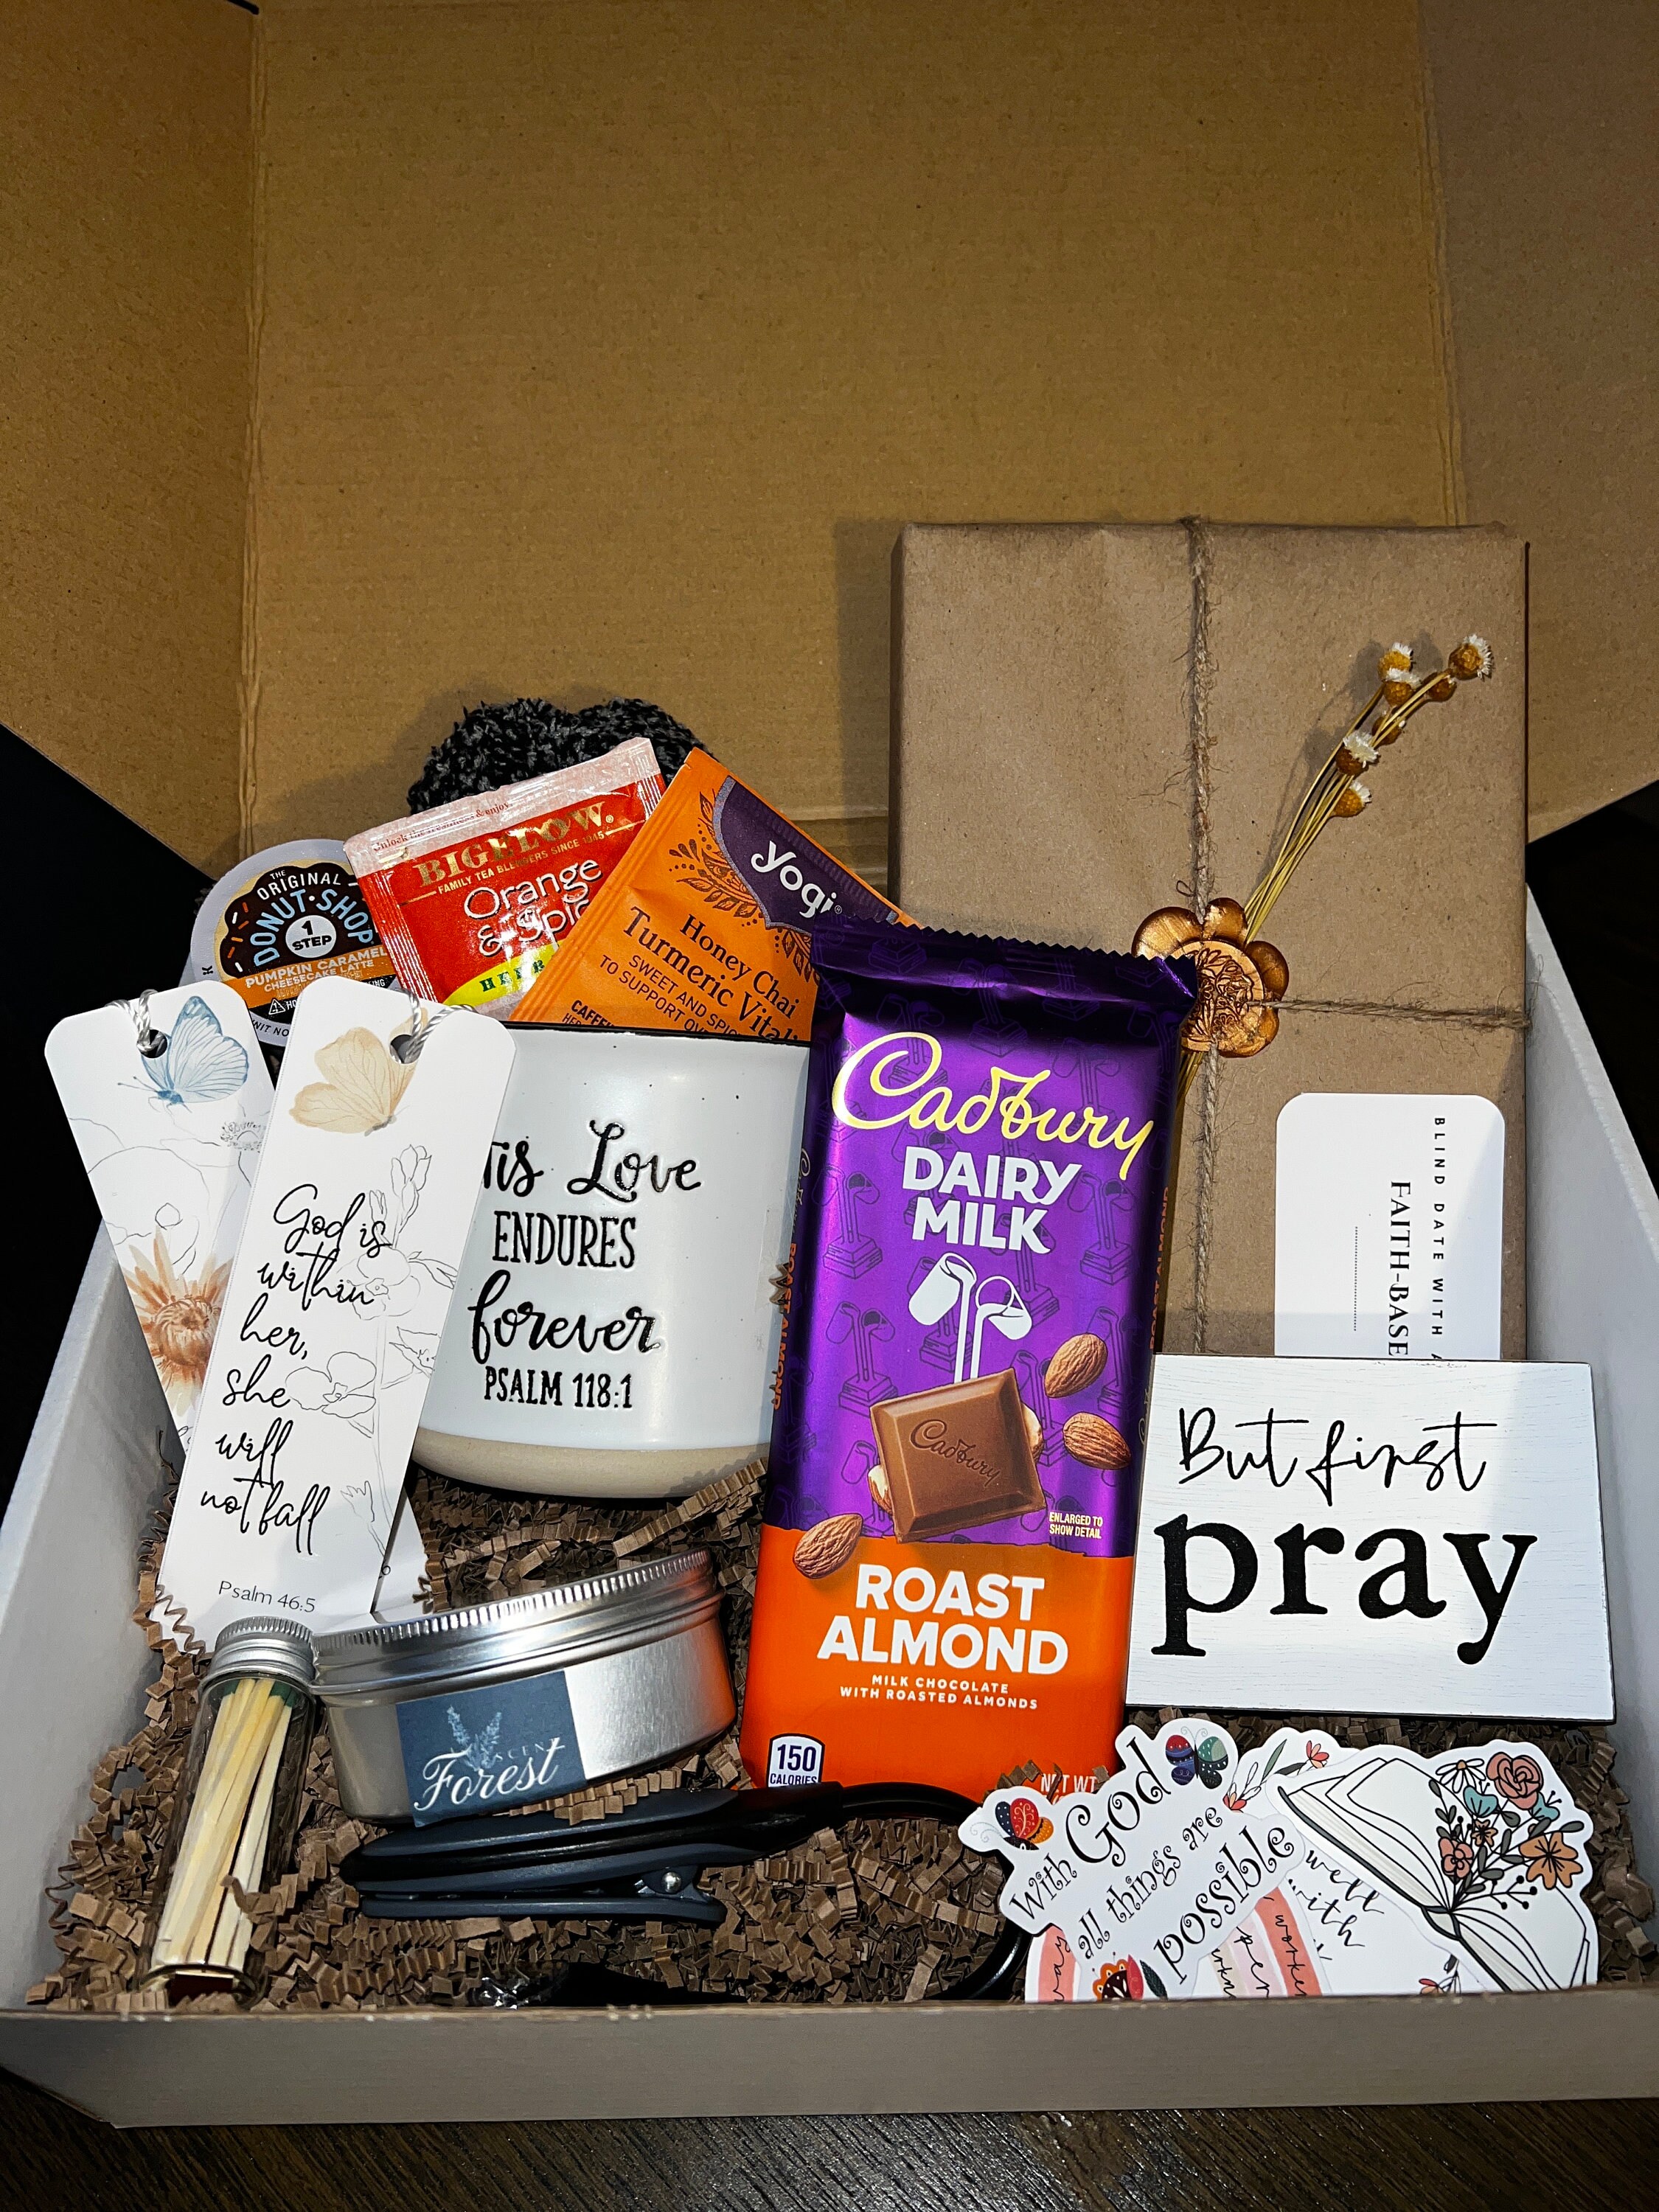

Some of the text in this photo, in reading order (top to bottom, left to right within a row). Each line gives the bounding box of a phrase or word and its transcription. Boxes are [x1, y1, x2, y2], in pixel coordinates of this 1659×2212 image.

[270, 869, 286, 880] THE
[413, 801, 605, 888] BIGELOW
[438, 875, 471, 894] FAMILY
[474, 868, 495, 882] TEA
[551, 838, 580, 855] SINCE
[257, 872, 341, 900] ORIGINAL
[464, 860, 602, 919] Orange
[751, 840, 838, 918] yogi
[250, 888, 373, 967] DONUT SHOP
[292, 935, 333, 951] STEP
[302, 920, 313, 936] 1
[246, 947, 388, 989] PUMPKIN CARAMEL
[264, 968, 336, 992] CHEESECAKE
[340, 959, 375, 974] LATTE
[599, 954, 709, 1032] TO SUPPORT OV
[623, 906, 799, 1040] Turmeric Vital
[628, 955, 678, 994] SWEET
[676, 991, 707, 1018] AND
[680, 914, 799, 1019] Honey Chai
[252, 1019, 272, 1033] NIT
[832, 1032, 1155, 1181] Cadbury
[567, 1119, 702, 1203] Love
[902, 1146, 1082, 1206] DAIRY
[273, 1183, 394, 1259] God is
[493, 1210, 637, 1269] ENDURES
[912, 1197, 1051, 1254] MILK
[1431, 1117, 1446, 1335] BLIND DATE WITH
[257, 1242, 375, 1310] within
[240, 1293, 308, 1361] her,
[467, 1269, 661, 1366] forever
[222, 1354, 291, 1408] she
[484, 1366, 633, 1409] PSALM 118:1
[215, 1417, 294, 1487] will
[911, 1419, 1001, 1487] Cadbury
[1178, 1407, 1310, 1488] But
[1306, 1411, 1498, 1507] first
[200, 1467, 332, 1556] not fall
[1048, 1512, 1103, 1527] ENLARGED TO
[1049, 1523, 1102, 1539] SHOW DETAIL
[218, 1580, 316, 1614] Psalm 46:5
[855, 1563, 1046, 1621] ROAST
[1151, 1513, 1538, 1665] pray
[816, 1615, 1068, 1674] ALMOND
[840, 1686, 1038, 1709] WITH ROASTED ALMONDS
[872, 1674, 1009, 1694] MILK CHOCOLATE
[414, 1736, 566, 1811] Forest
[770, 1773, 817, 1785] CALORIES
[777, 1744, 816, 1772] 150
[1041, 1773, 1070, 1793] NT
[1009, 1736, 1172, 1921] With God
[1078, 1806, 1223, 1960] all things are
[1153, 1825, 1295, 1986] possible
[1306, 1850, 1385, 1914] well
